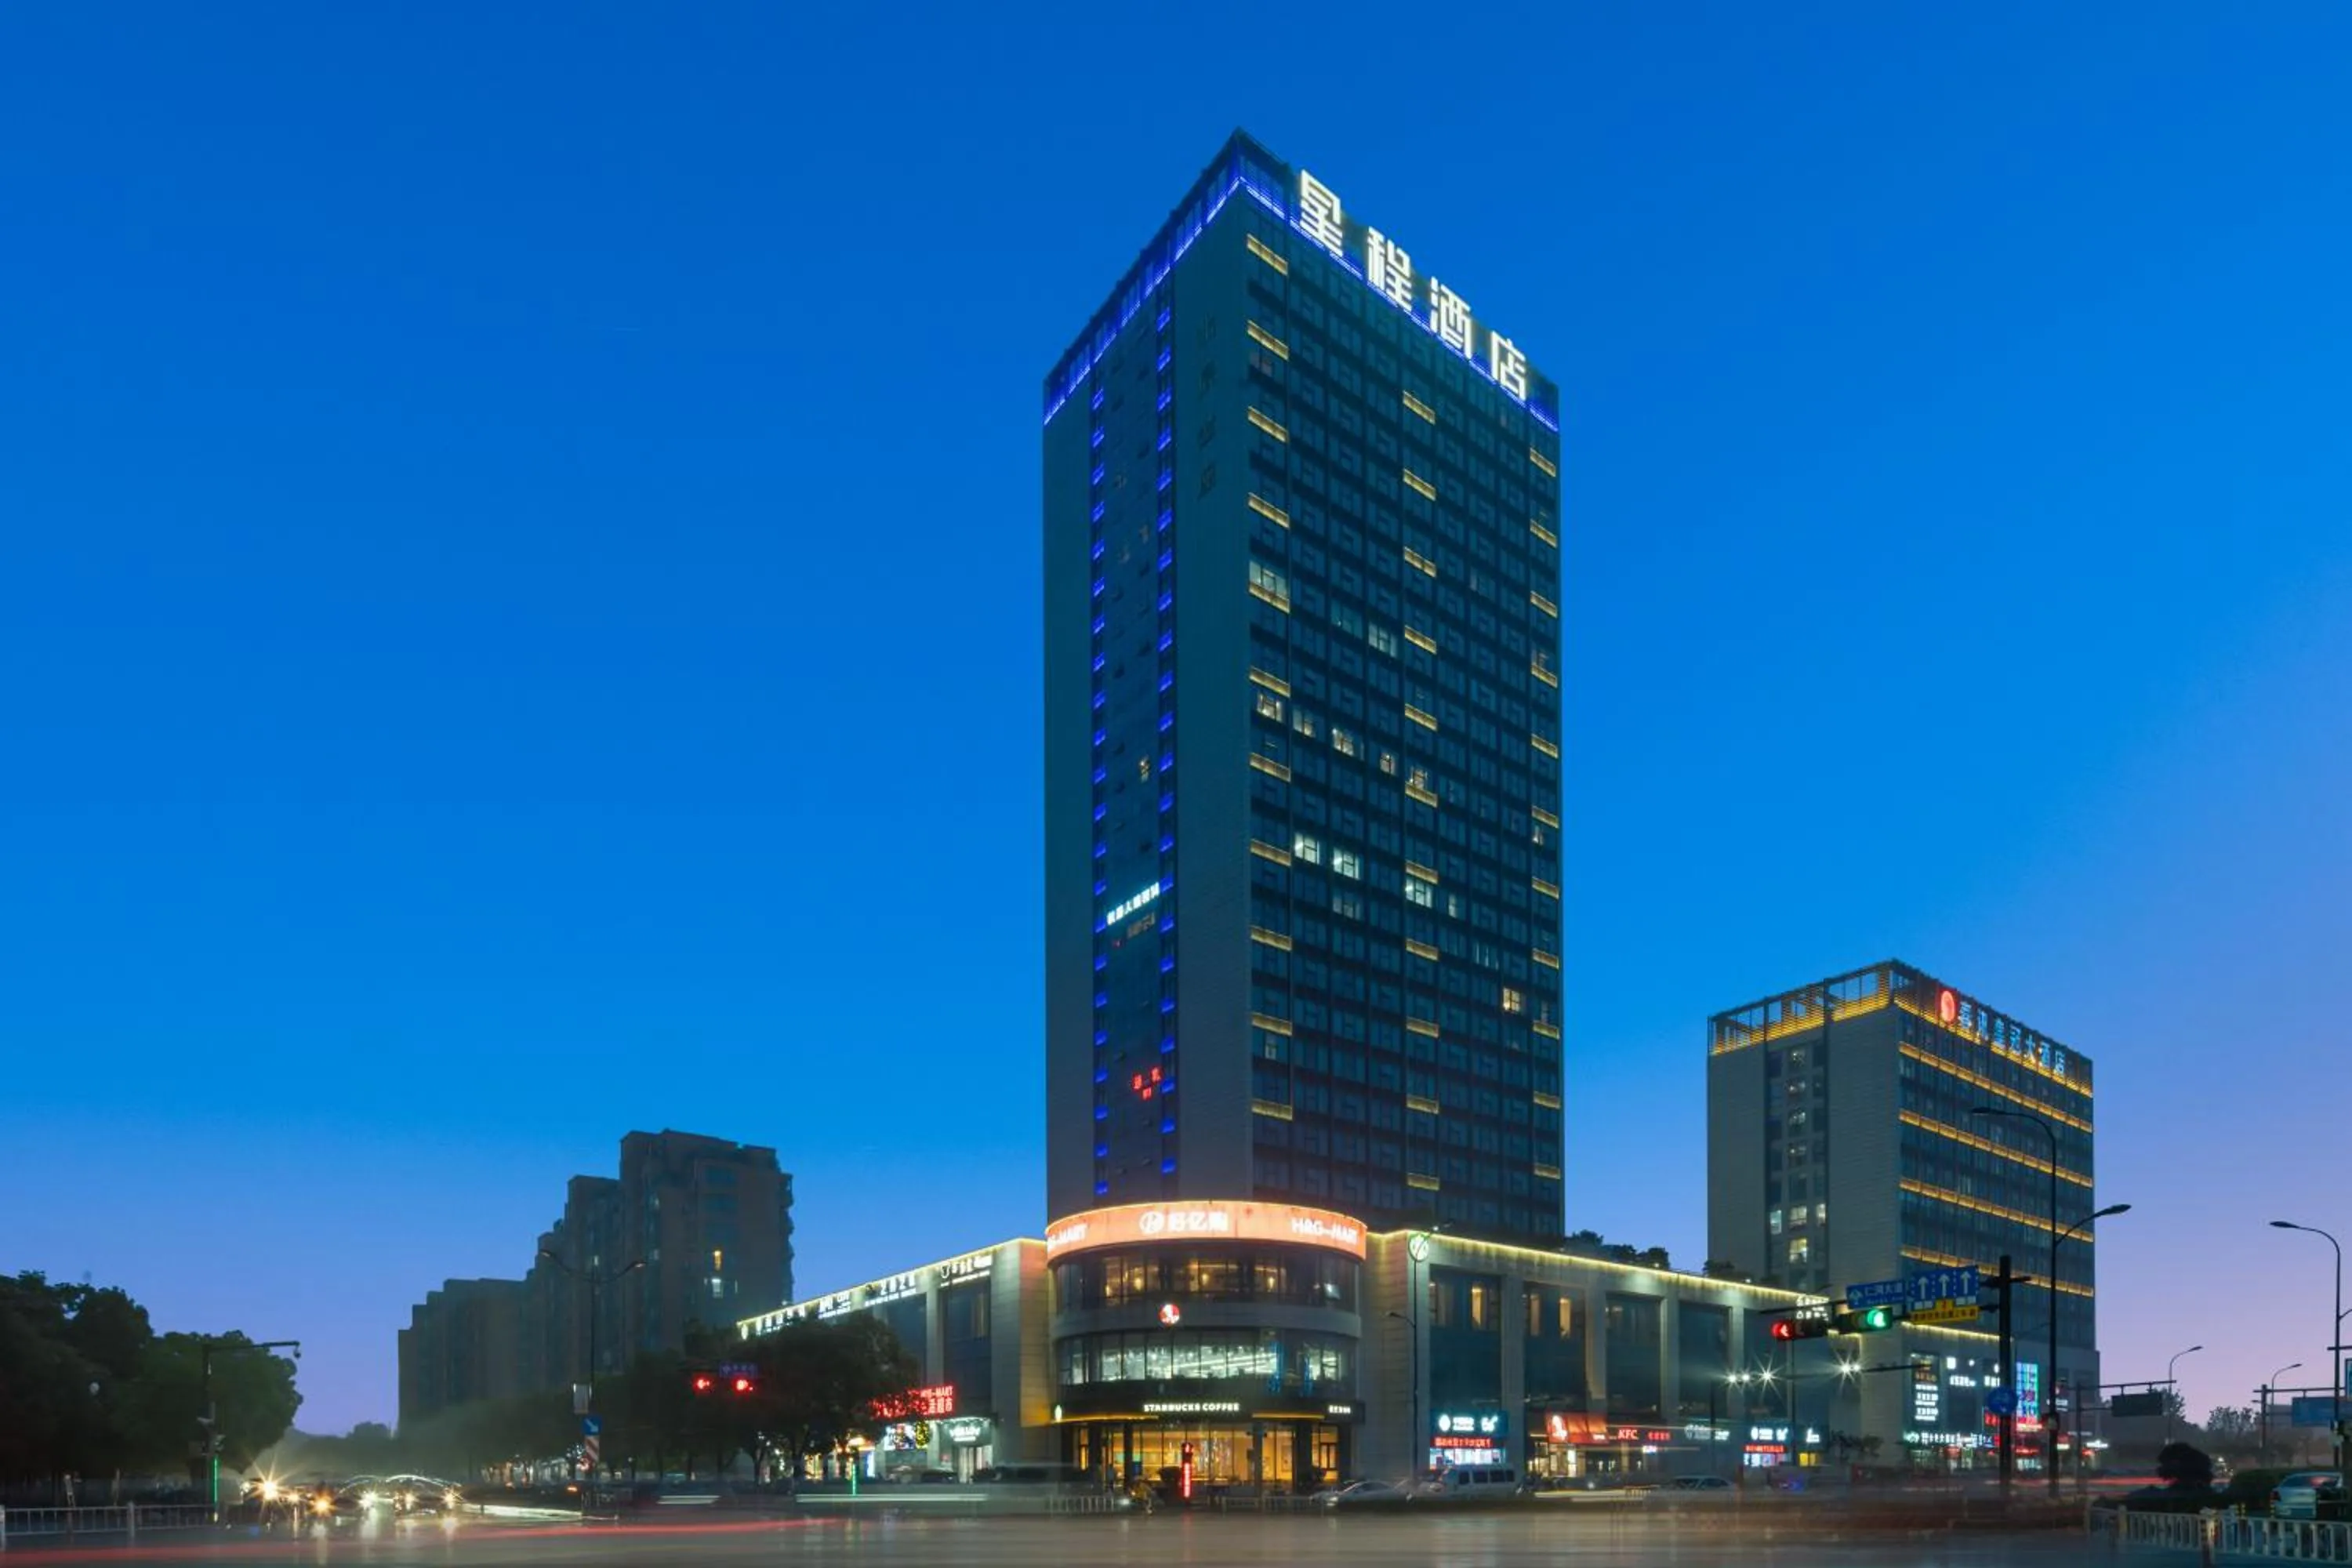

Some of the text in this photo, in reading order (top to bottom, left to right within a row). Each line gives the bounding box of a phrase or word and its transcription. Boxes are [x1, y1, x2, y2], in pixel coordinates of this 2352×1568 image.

[1299, 169, 1527, 401] 星程酒店
[1144, 1403, 1240, 1412] STARBUCKS COFFEE
[1618, 1429, 1638, 1439] KFC
